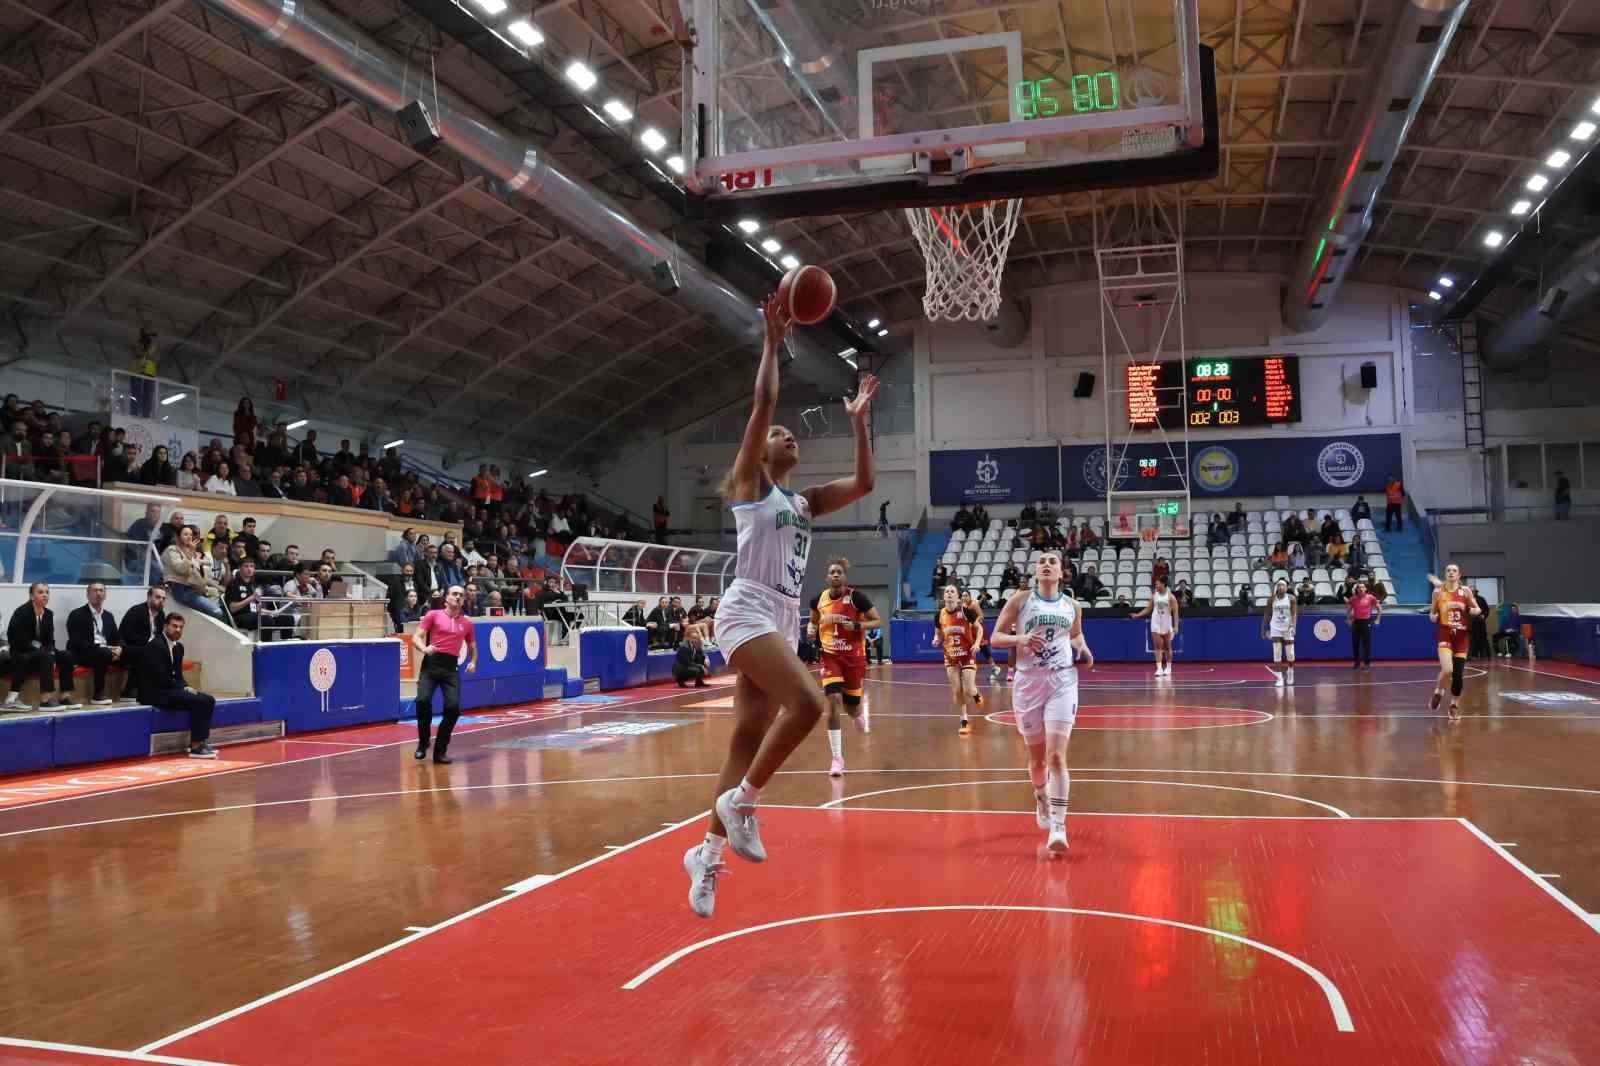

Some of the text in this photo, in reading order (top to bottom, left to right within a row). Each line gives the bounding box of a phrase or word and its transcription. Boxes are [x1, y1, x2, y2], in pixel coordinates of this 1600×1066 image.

[1196, 363, 1229, 376] 08 28
[1197, 388, 1232, 402] 00 00
[1190, 411, 1240, 425] 002 003
[795, 533, 808, 560] 31
[1045, 628, 1055, 642] 8
